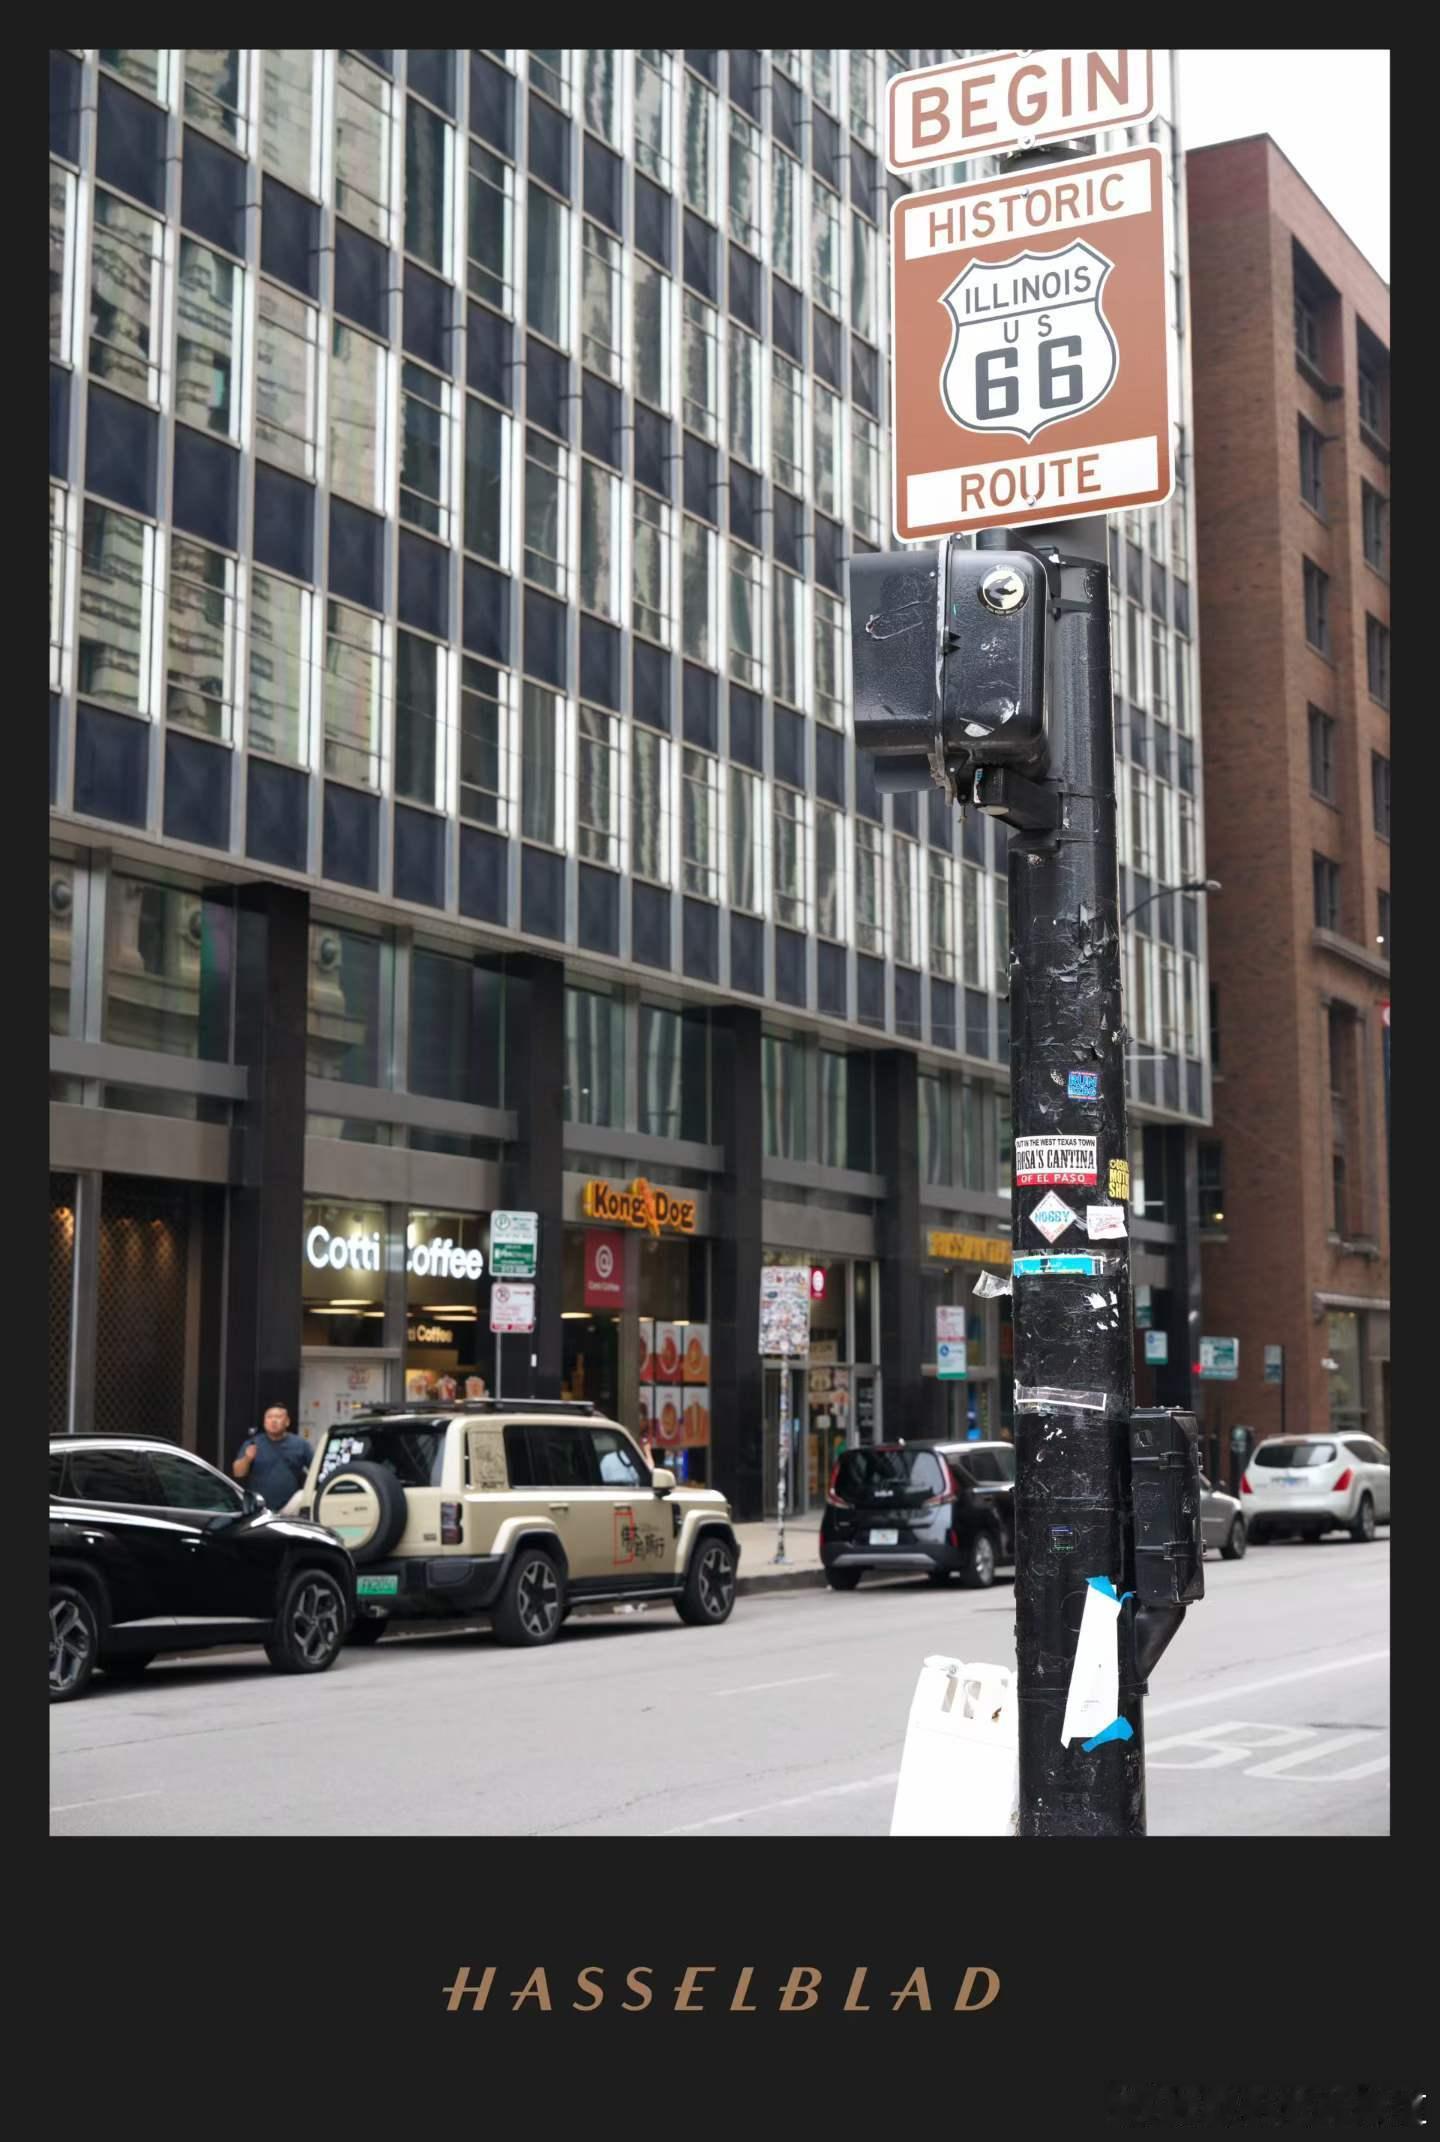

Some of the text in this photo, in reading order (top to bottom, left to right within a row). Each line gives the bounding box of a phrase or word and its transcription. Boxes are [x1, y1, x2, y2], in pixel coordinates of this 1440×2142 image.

[911, 51, 1130, 149] BEGIN
[929, 173, 1126, 248] HISTORIC
[965, 265, 1092, 314] ILLINOIS
[975, 334, 1084, 421] 66
[960, 452, 1102, 512] ROUTE
[1041, 1138, 1055, 1146] WEST
[1058, 1138, 1077, 1146] TEXAS
[1078, 1138, 1095, 1147] TOWN
[1047, 1149, 1095, 1169] CANTINA
[1021, 1174, 1085, 1183] OF EL PASO
[586, 1179, 696, 1233] Kong Dog
[307, 1225, 484, 1280] Cotti offee
